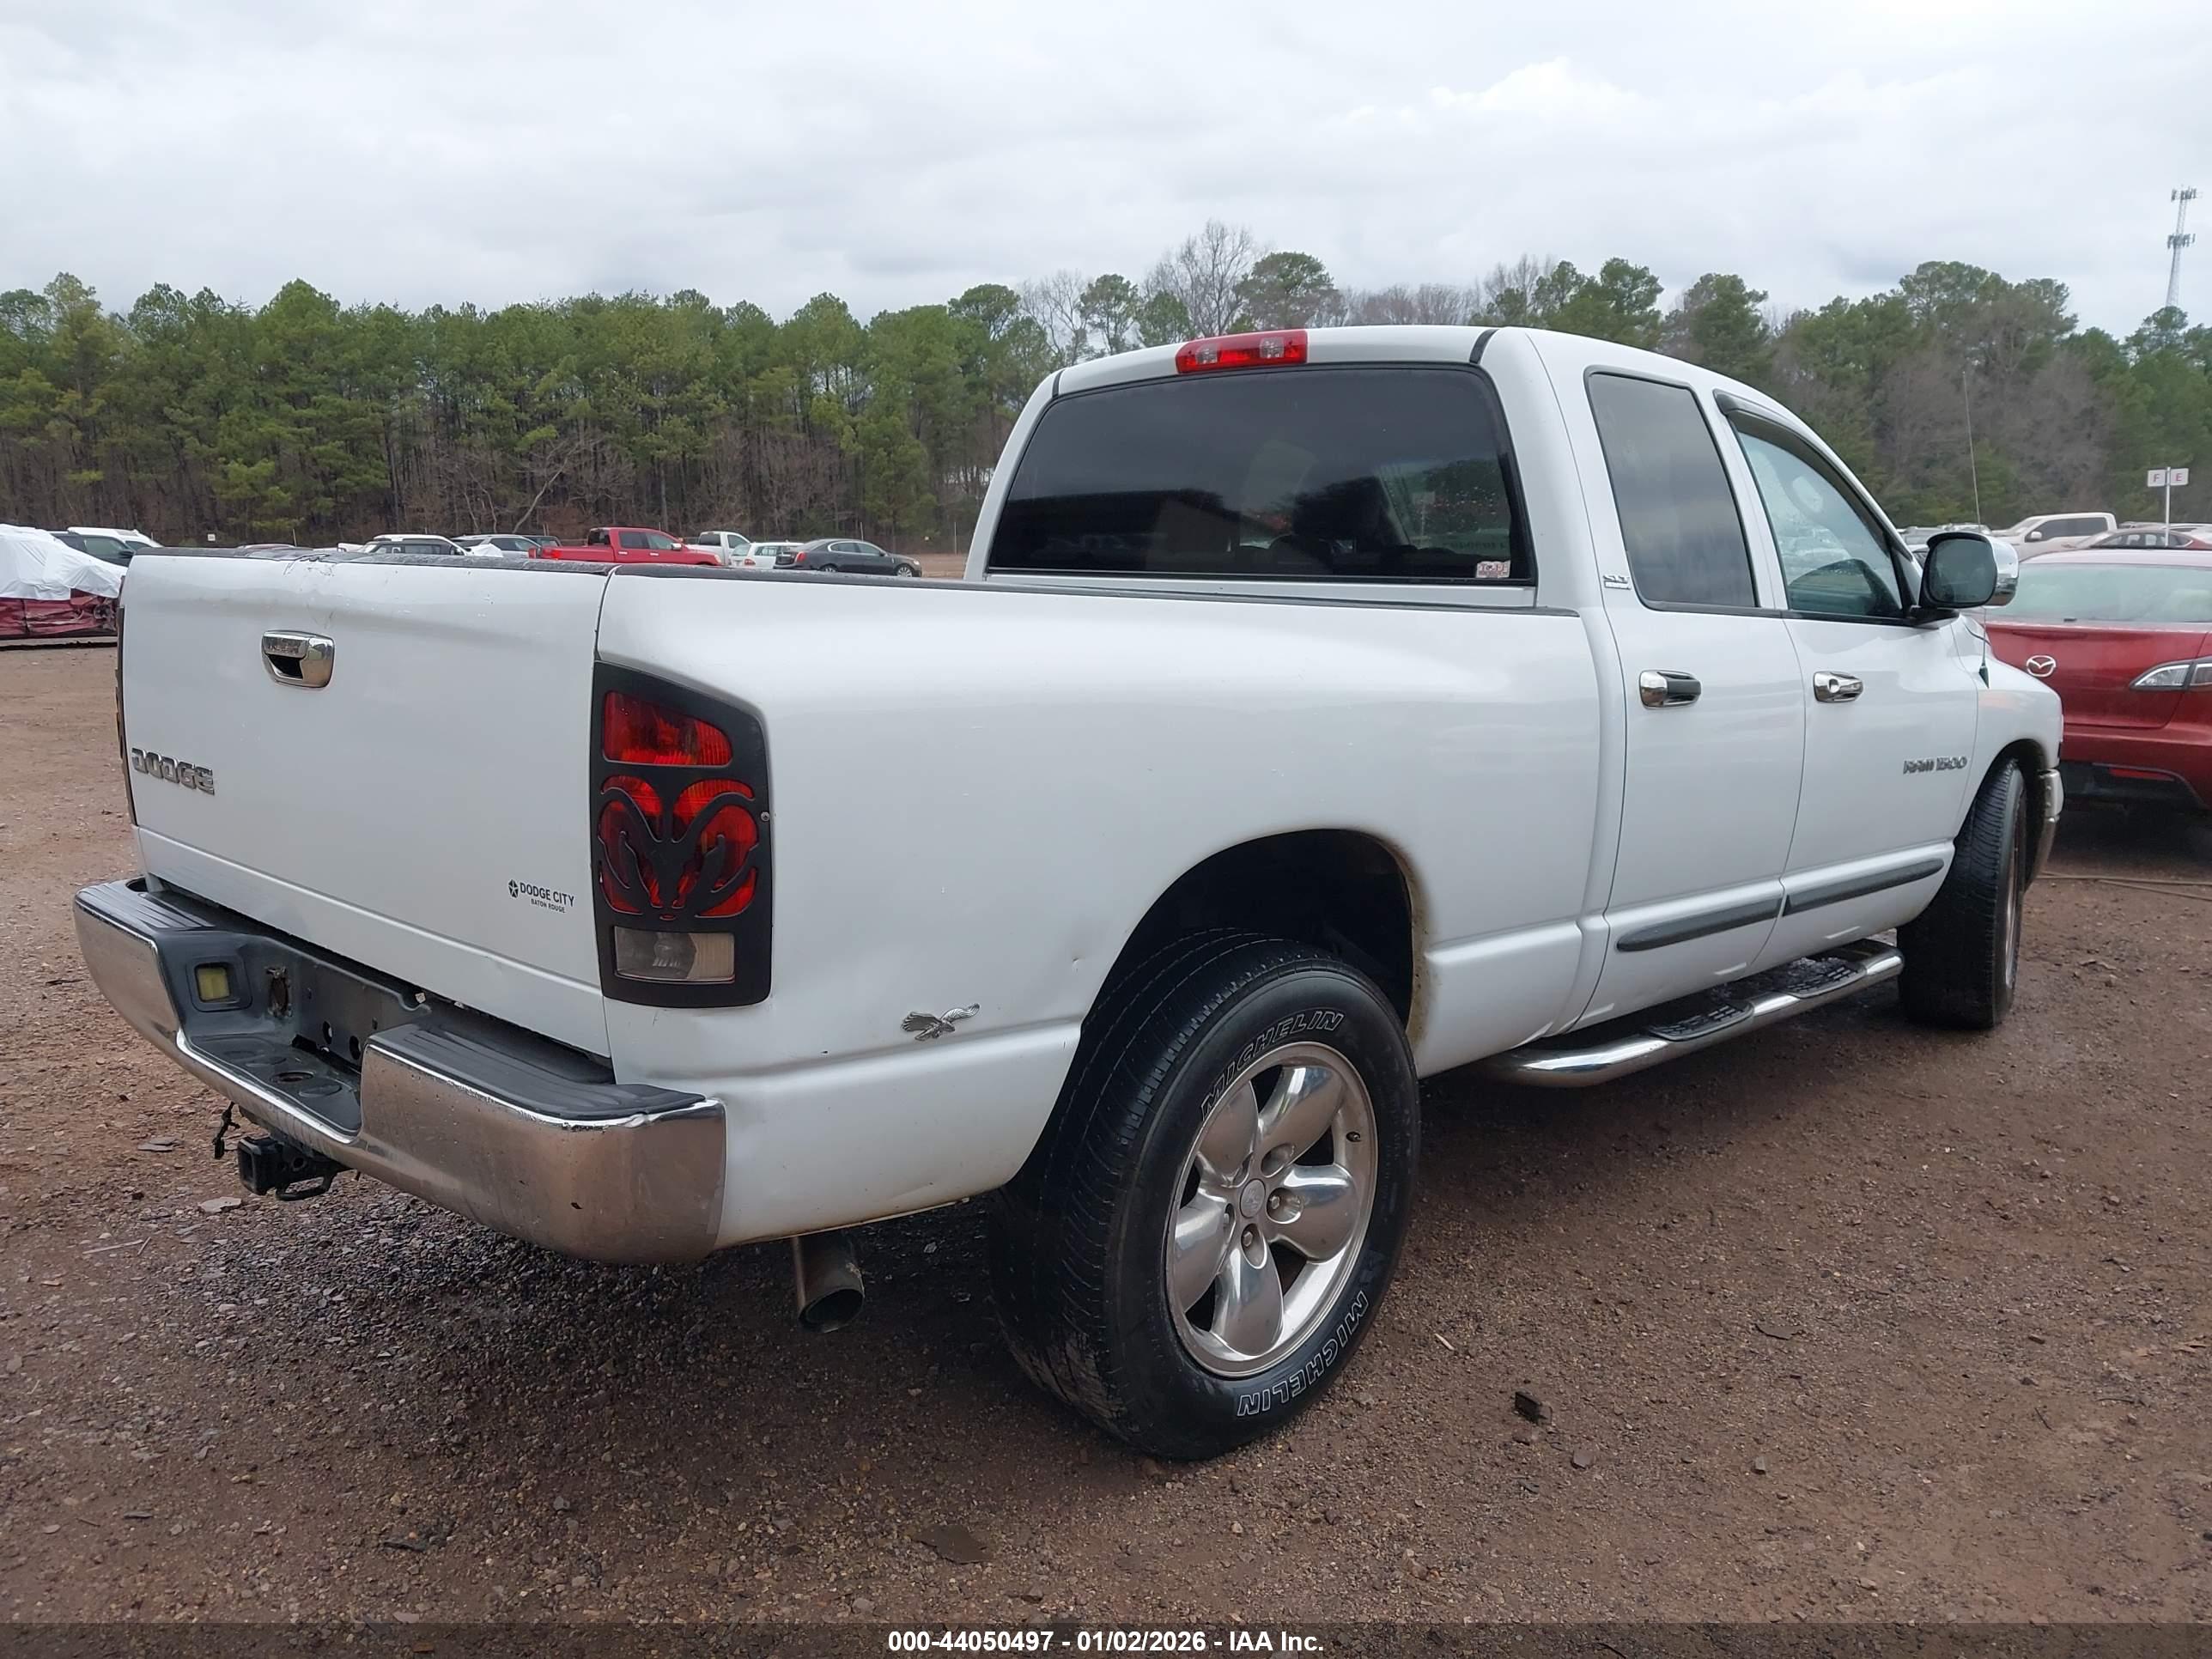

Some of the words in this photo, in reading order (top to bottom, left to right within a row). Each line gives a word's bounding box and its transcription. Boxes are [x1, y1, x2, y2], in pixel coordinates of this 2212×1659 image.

[131, 747, 215, 796] DODGE
[1903, 759, 1935, 775] RAM
[1936, 756, 1967, 771] 1500
[520, 882, 551, 901] DODGE
[553, 890, 574, 907] CITY
[531, 898, 547, 908] BATON
[548, 902, 566, 913] ROUGE
[1201, 1010, 1345, 1121] MICHELIN
[1237, 1290, 1370, 1417] MICHELIN
